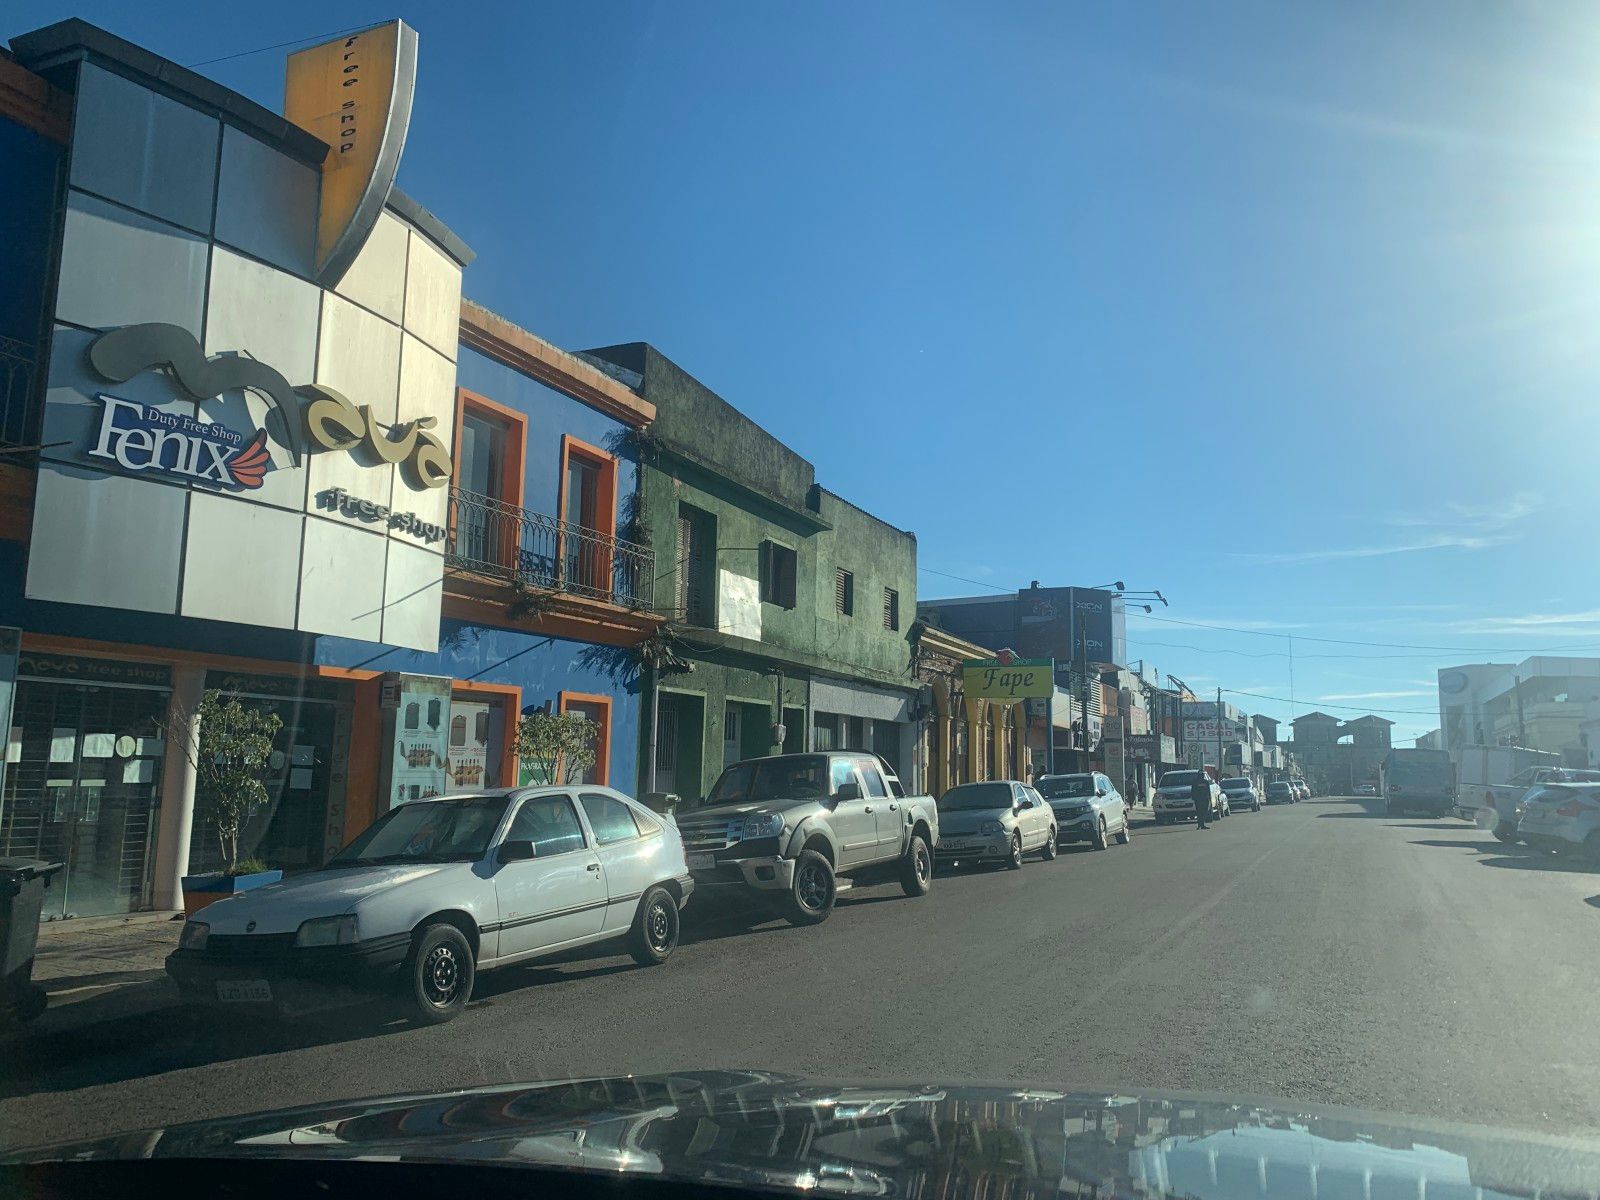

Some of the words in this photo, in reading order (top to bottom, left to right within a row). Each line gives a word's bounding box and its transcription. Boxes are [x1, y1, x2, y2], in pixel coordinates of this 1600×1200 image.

[88, 394, 240, 486] Fenix
[148, 408, 178, 429] Duty
[183, 418, 209, 434] Free
[212, 425, 242, 444] Shop
[397, 511, 448, 543] shop
[128, 666, 166, 681] shop
[982, 668, 1034, 696] Fape
[1187, 722, 1233, 730] CASAL
